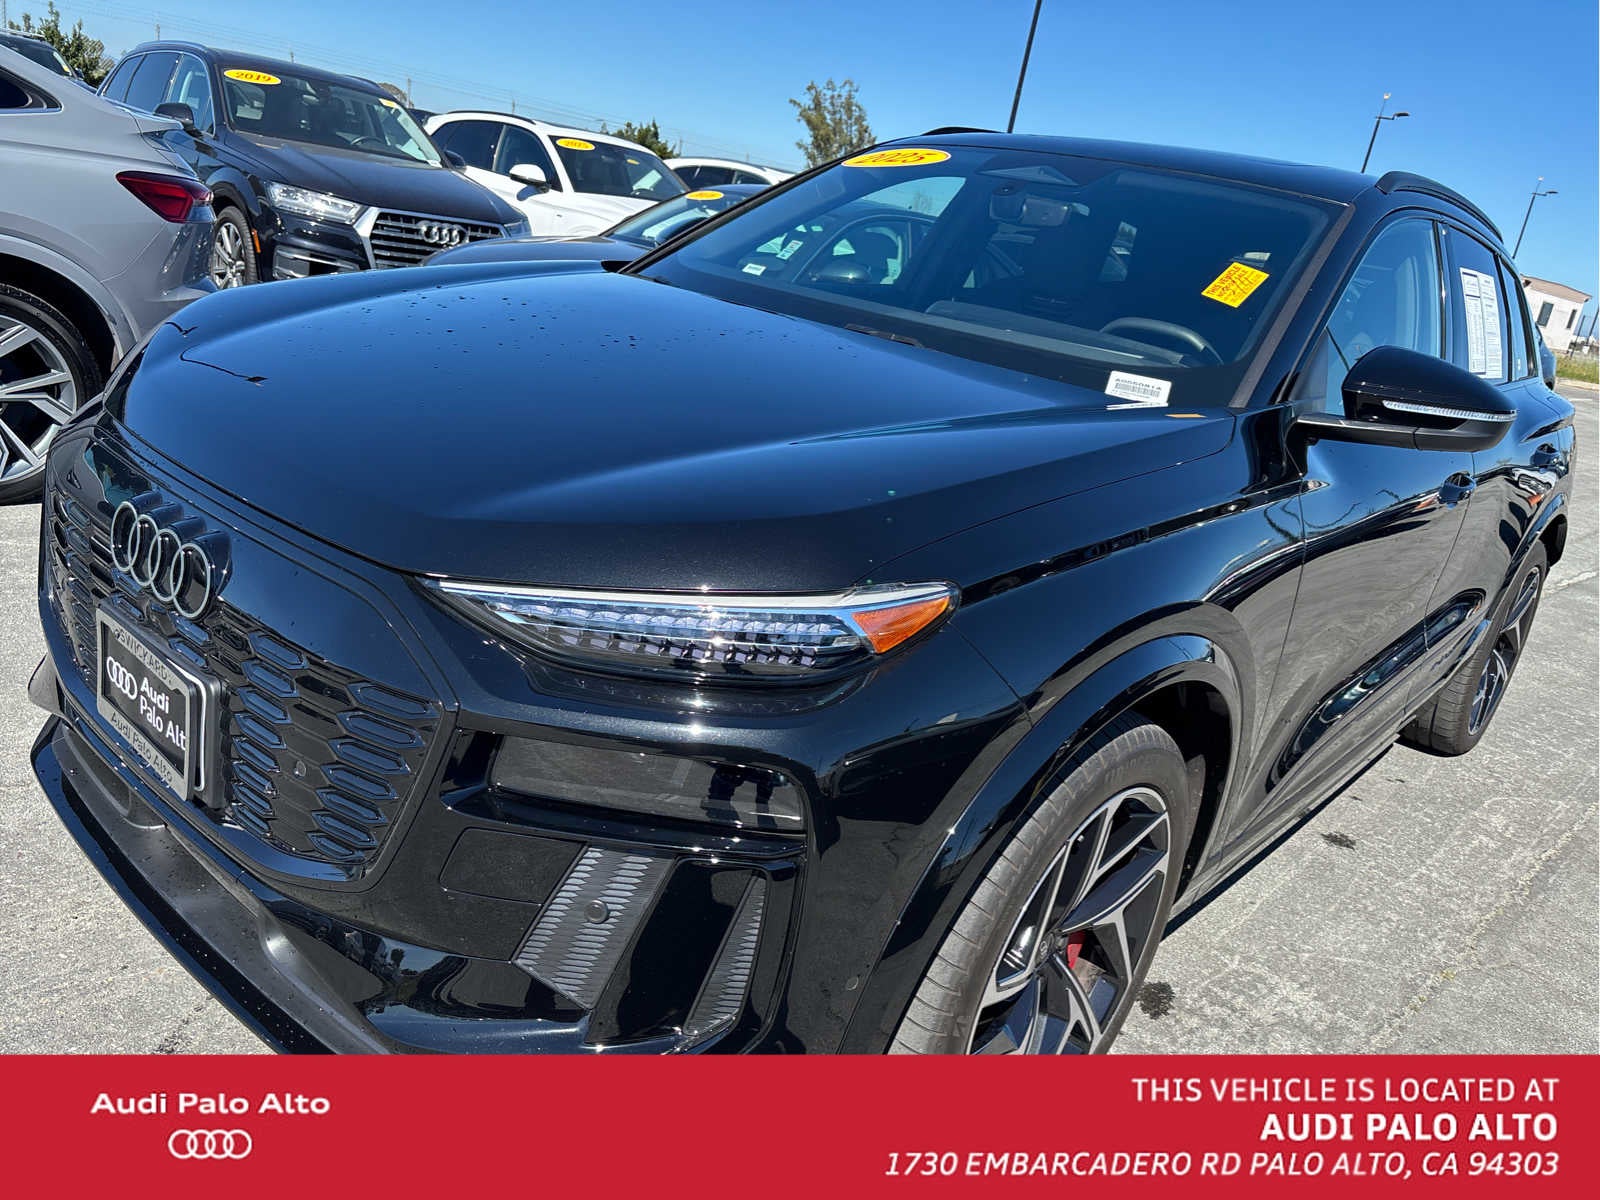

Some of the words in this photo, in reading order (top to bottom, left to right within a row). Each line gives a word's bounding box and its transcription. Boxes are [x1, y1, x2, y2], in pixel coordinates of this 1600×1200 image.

[235, 72, 272, 82] 2019
[853, 152, 938, 164] 2025
[140, 677, 169, 714] Audi
[140, 695, 163, 733] Palo
[111, 712, 131, 739] Audi
[133, 731, 152, 760] Palo
[154, 755, 173, 782] Alto
